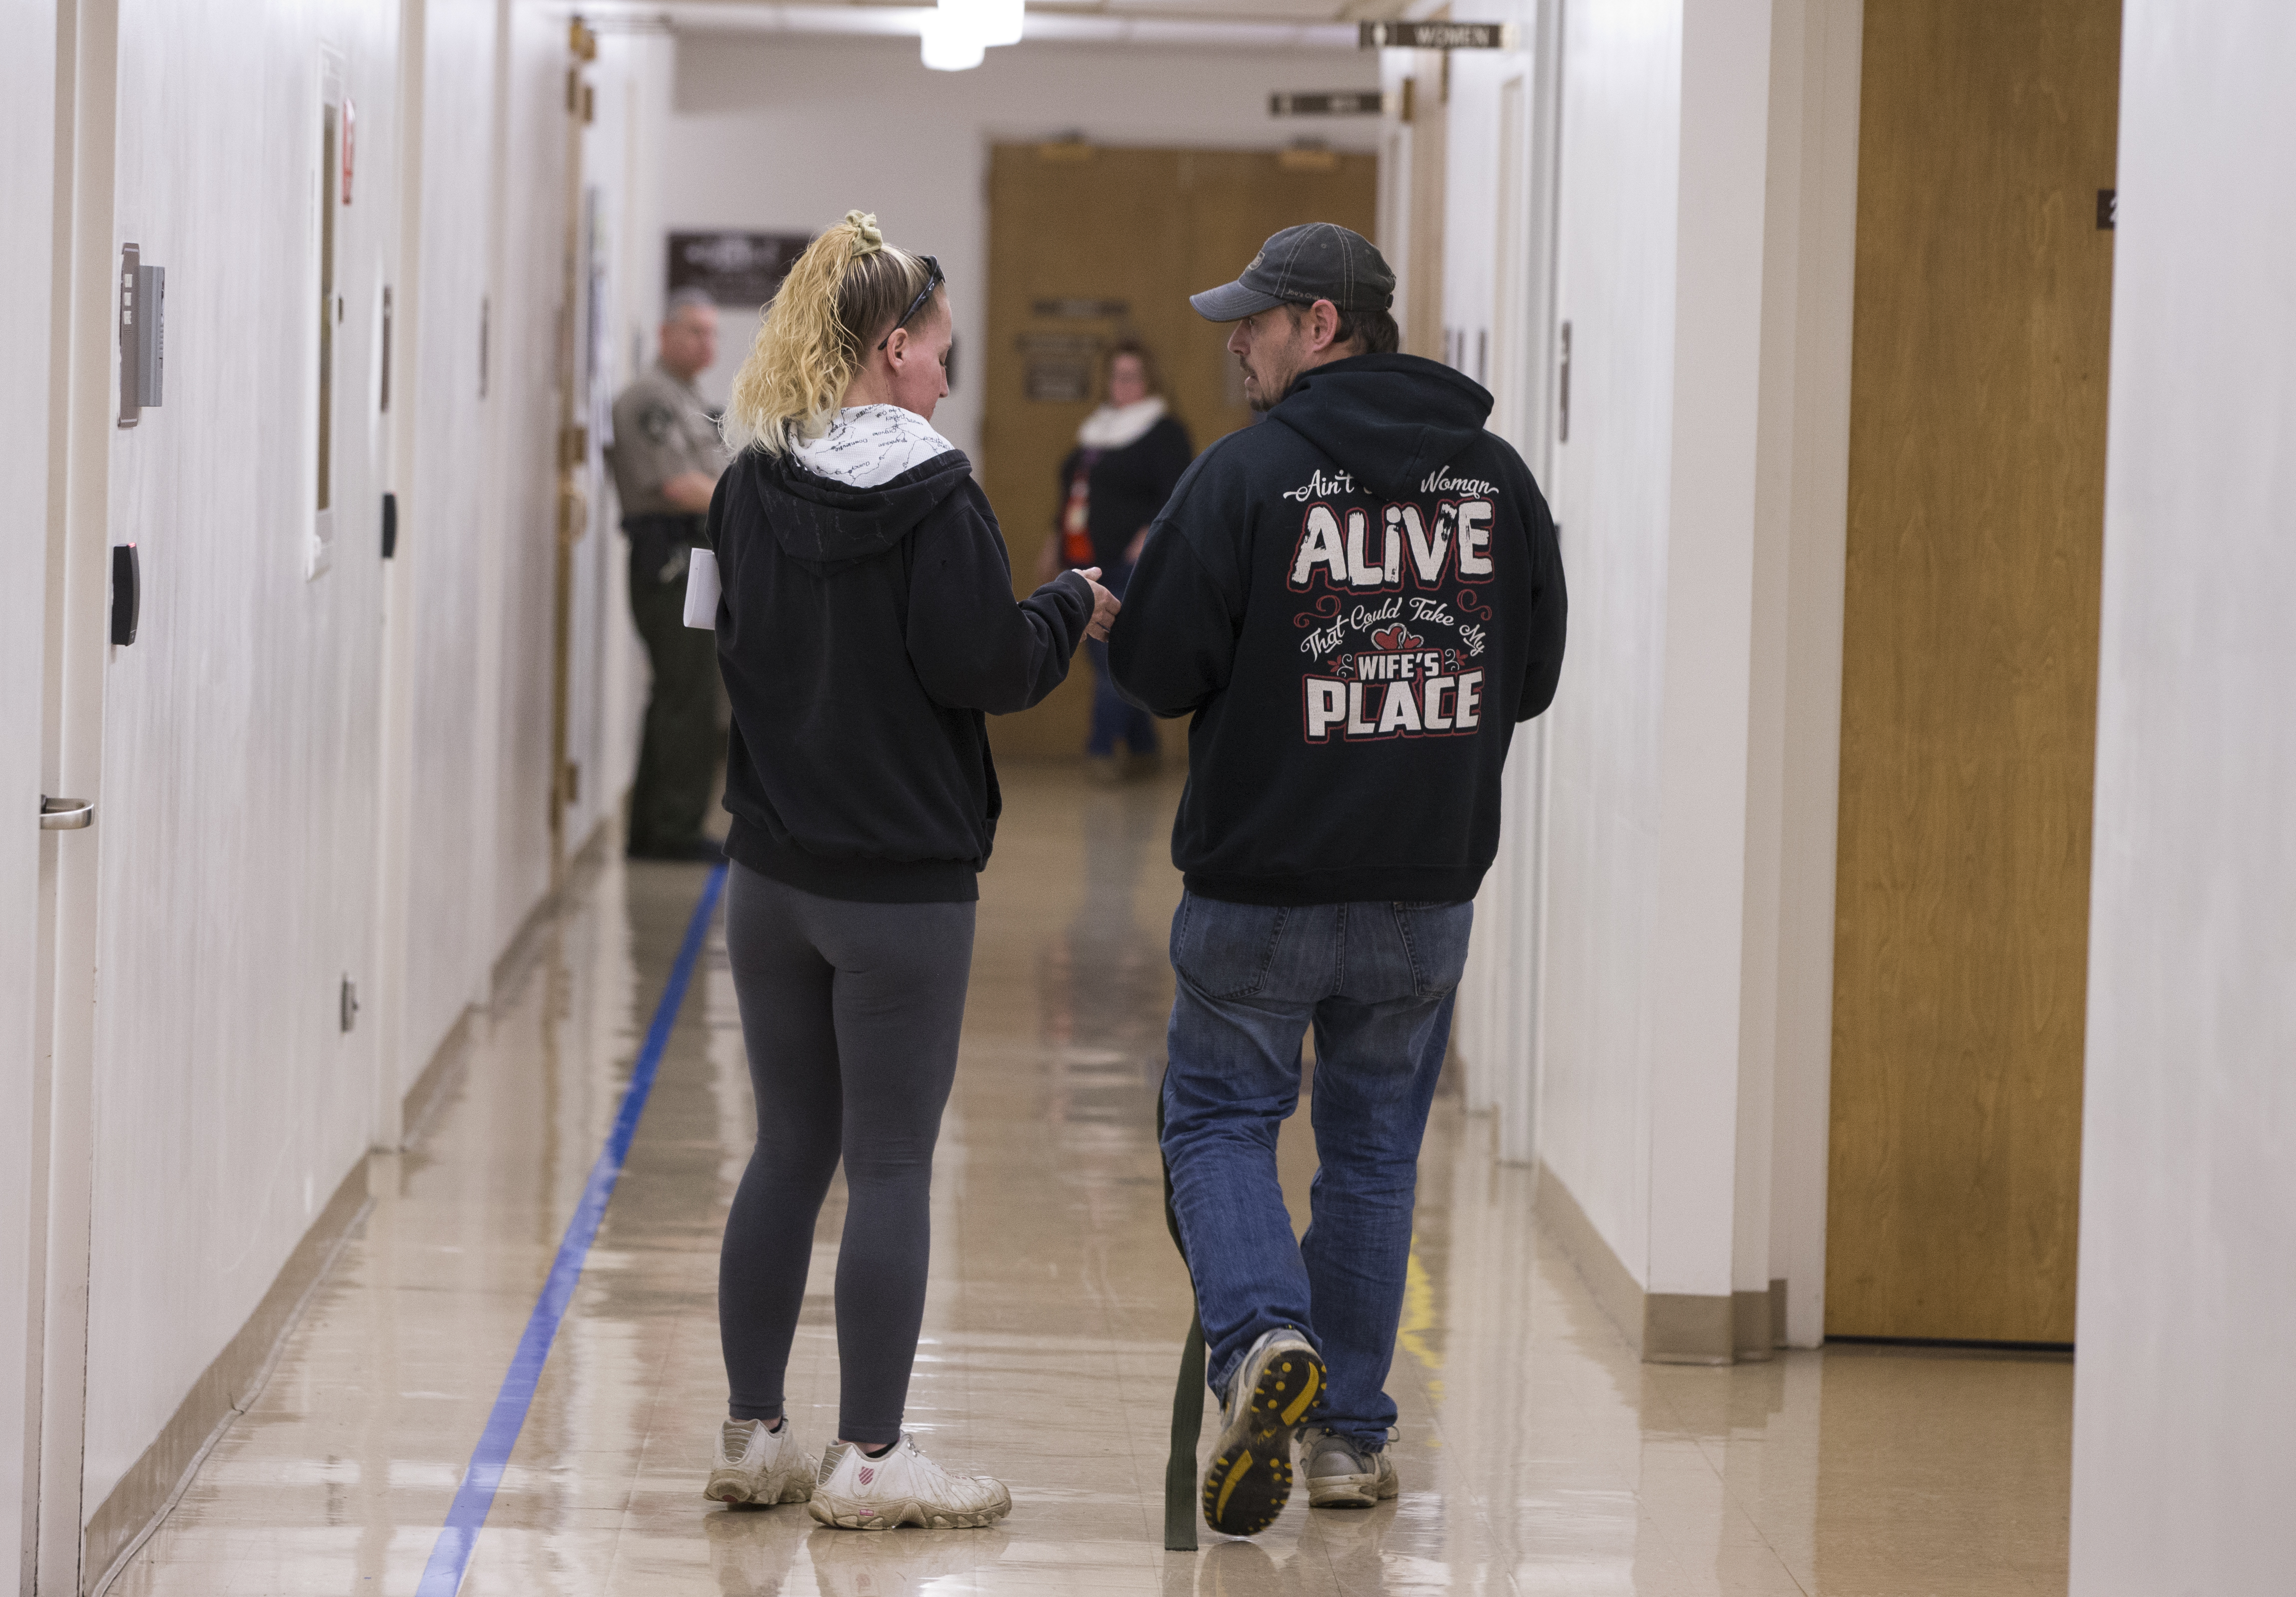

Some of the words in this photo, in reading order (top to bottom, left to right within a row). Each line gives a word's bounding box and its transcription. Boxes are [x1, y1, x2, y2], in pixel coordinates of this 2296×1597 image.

[1283, 469, 1354, 501] Ain't
[1421, 465, 1499, 498] Woman
[1300, 615, 1349, 662] That
[1350, 597, 1402, 633] Could
[1408, 597, 1455, 626] Take
[1459, 624, 1485, 656] My
[1358, 652, 1439, 680] WIFE'S
[1307, 670, 1484, 736] PLACE
